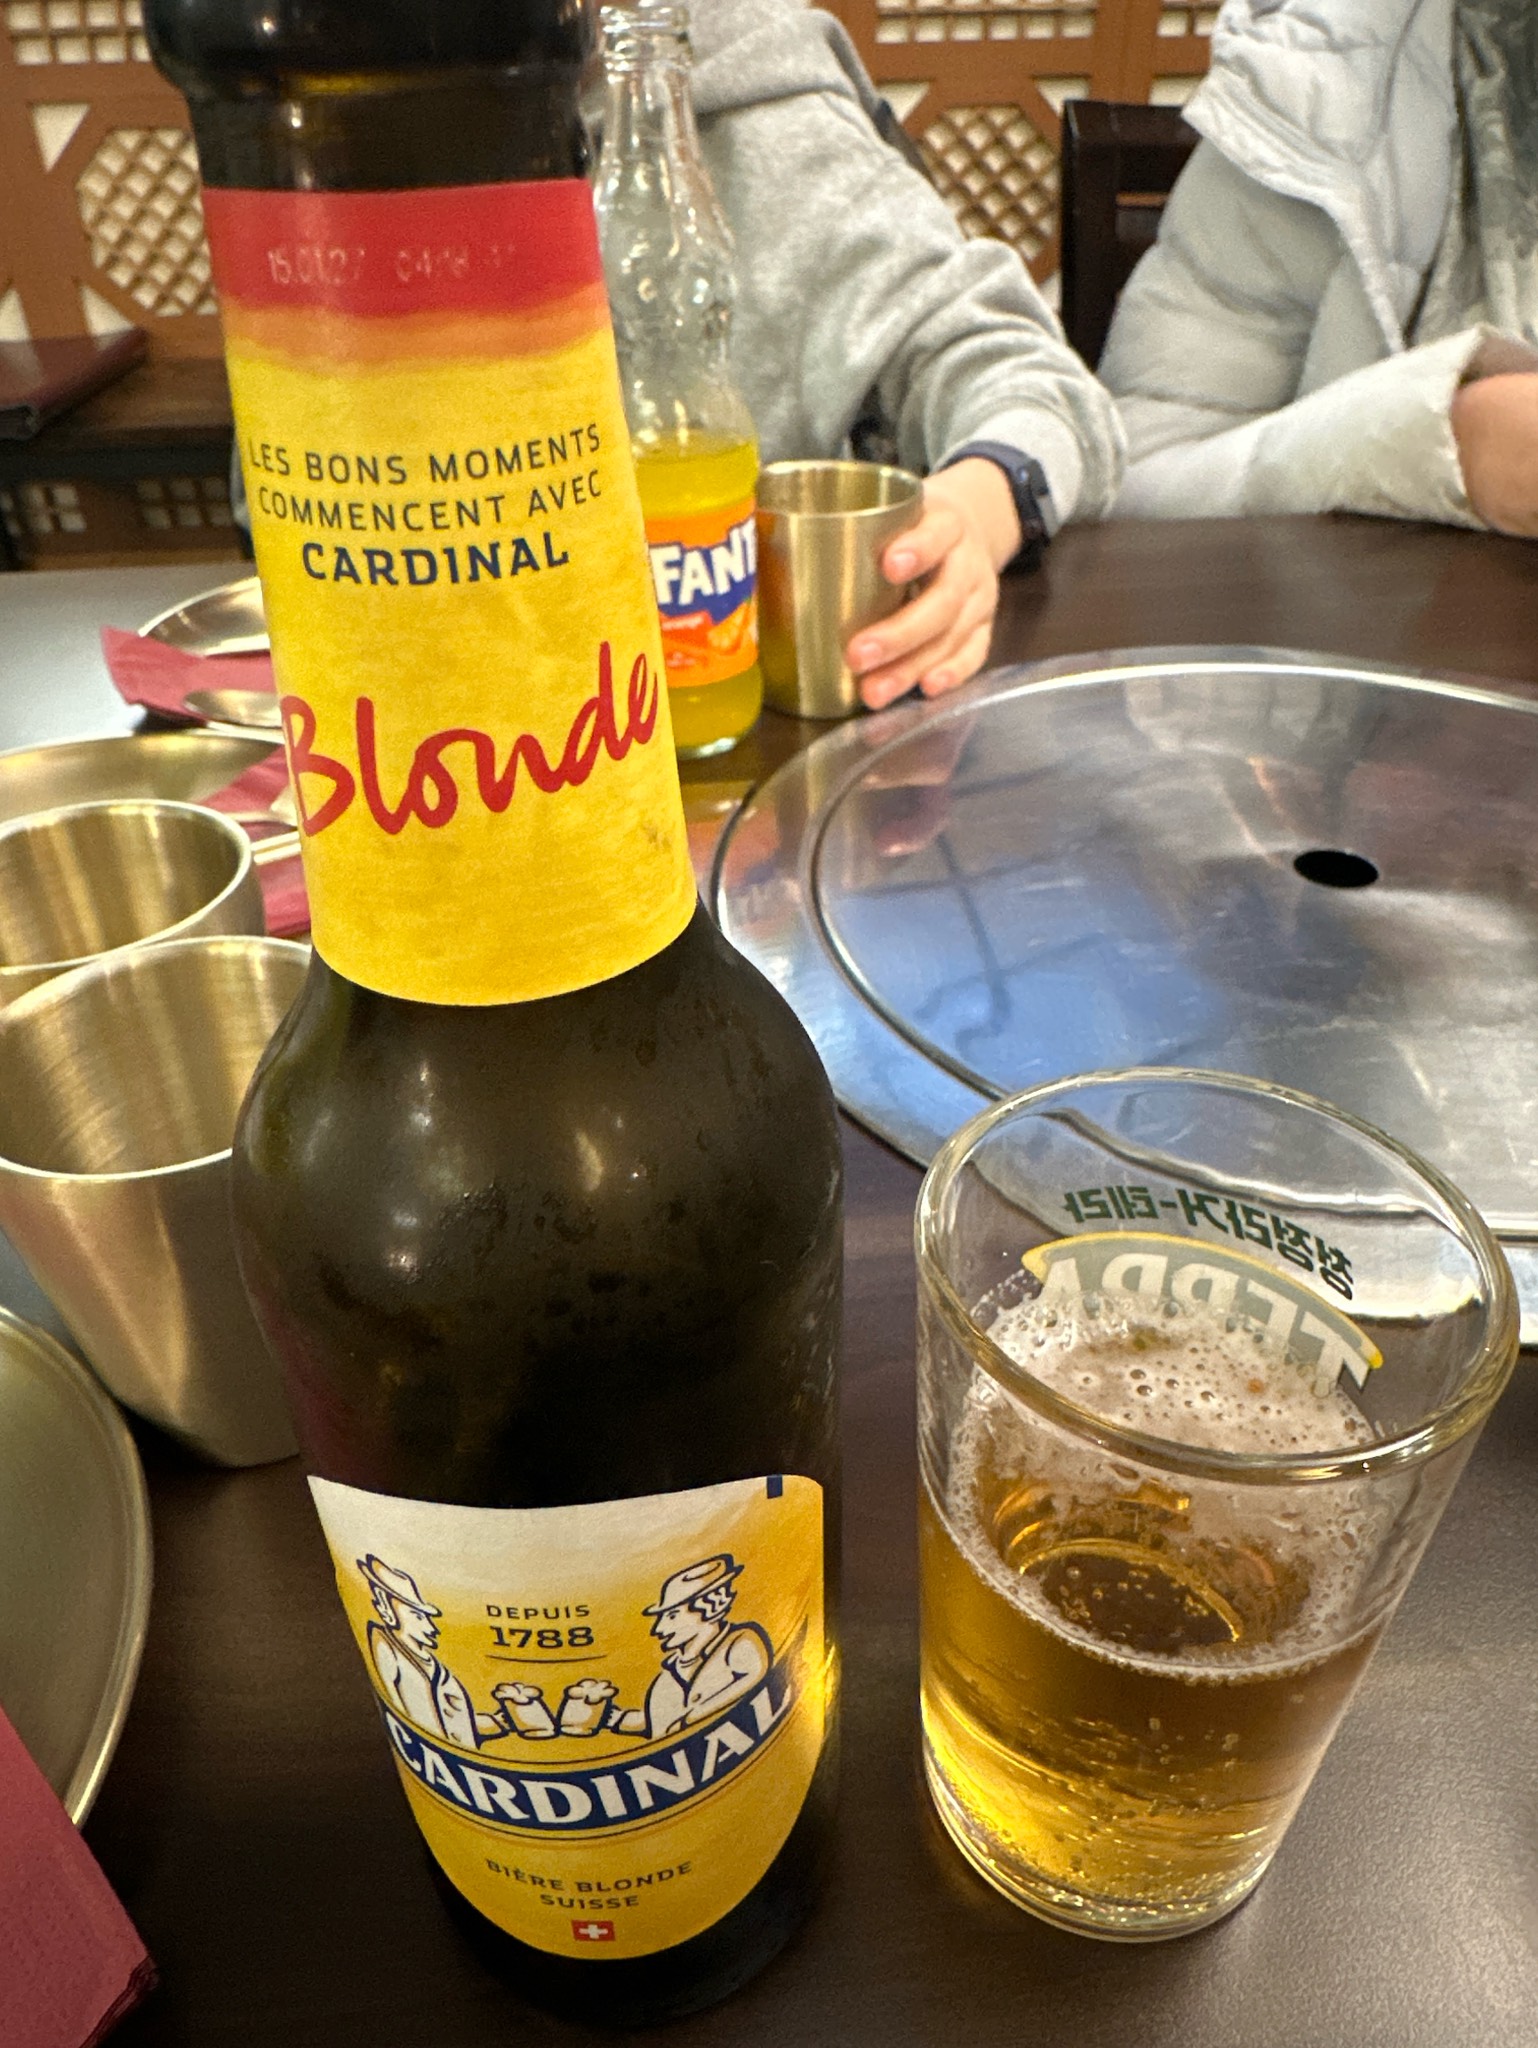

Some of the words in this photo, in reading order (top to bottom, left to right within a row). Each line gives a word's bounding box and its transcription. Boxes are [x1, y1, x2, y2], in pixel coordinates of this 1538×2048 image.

[247, 442, 291, 477] LES
[306, 453, 408, 485] BONS
[428, 423, 601, 484] MOMENTS
[257, 486, 506, 533] COMMENCENT
[526, 469, 602, 518] AVEC
[302, 530, 570, 586] CARDINAL
[279, 640, 659, 838] Blonde
[485, 1603, 592, 1622] DEPUIS
[491, 1625, 595, 1650] 1788
[385, 1685, 791, 1824] CARDINAL
[485, 1857, 564, 1891] BIÈRE
[575, 1860, 694, 1893] BLONDE
[539, 1893, 640, 1910] SUISSE
